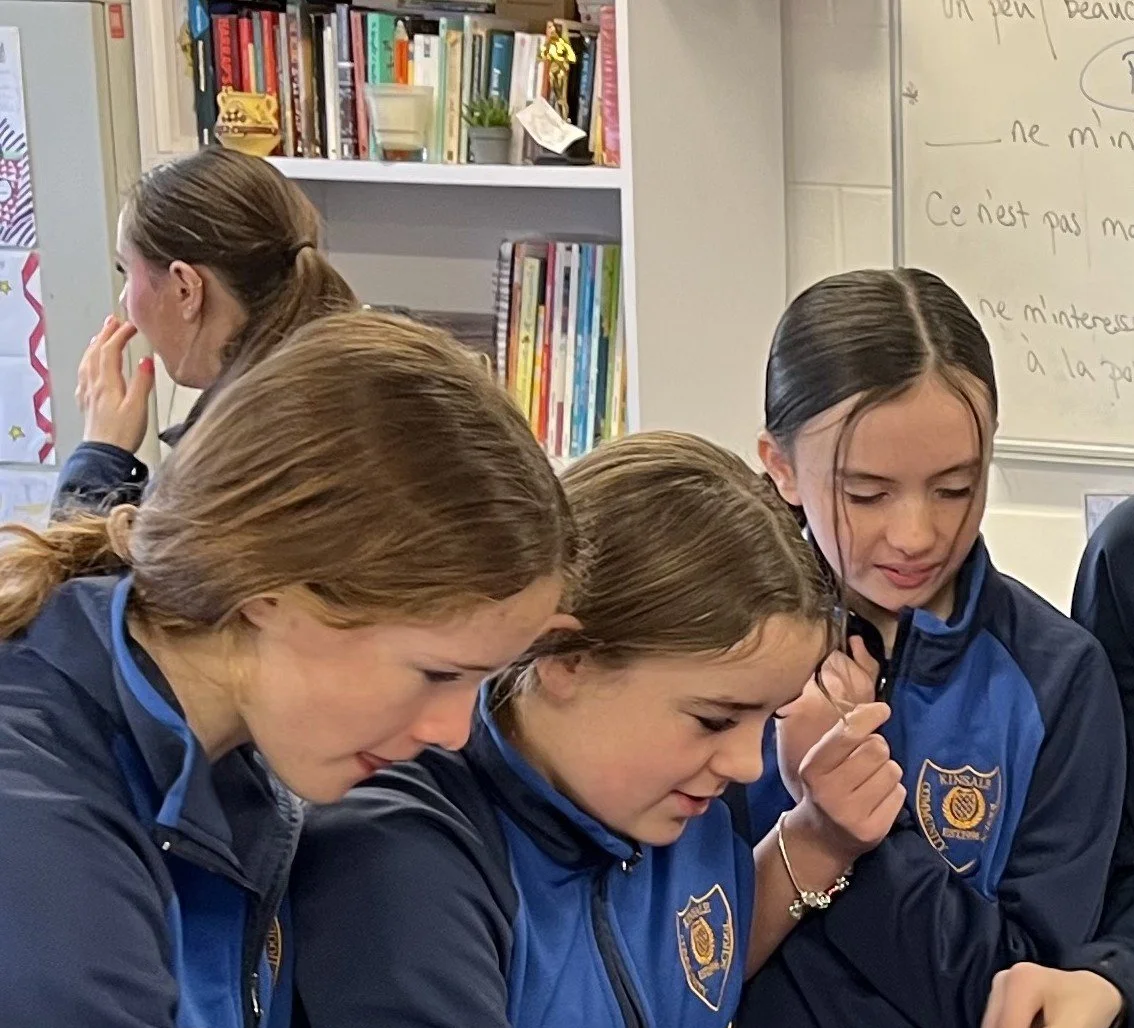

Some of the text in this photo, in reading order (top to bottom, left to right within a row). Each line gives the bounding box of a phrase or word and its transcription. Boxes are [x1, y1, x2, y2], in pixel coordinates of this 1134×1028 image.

[1011, 119, 1049, 147] ne
[925, 190, 967, 227] Ce
[976, 188, 1029, 229] n'est
[1043, 209, 1082, 254] pas
[979, 297, 1013, 322] ne
[1061, 347, 1096, 382] la
